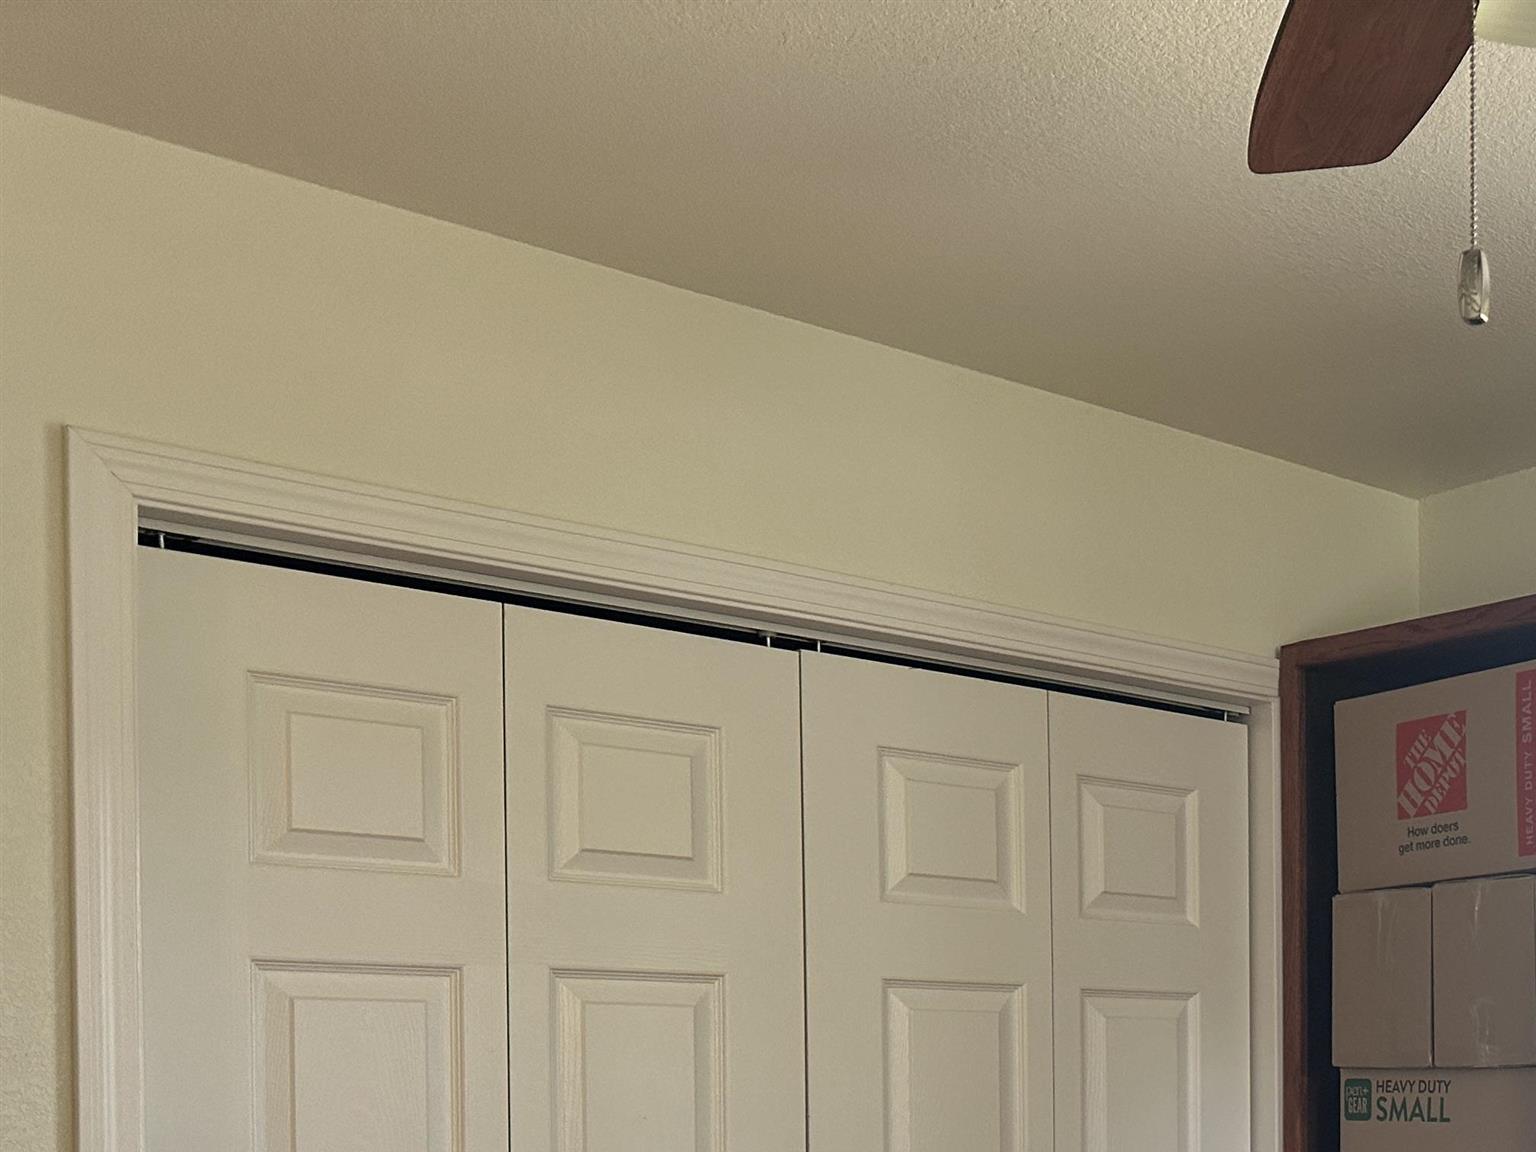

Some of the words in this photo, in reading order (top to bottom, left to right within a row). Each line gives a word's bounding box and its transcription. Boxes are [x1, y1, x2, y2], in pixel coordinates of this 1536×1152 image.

[1522, 680, 1532, 744] SMALL
[1397, 714, 1466, 818] HOME
[1405, 729, 1432, 769] THE
[1424, 748, 1466, 814] DEPOT
[1523, 751, 1533, 790] DUTY
[1407, 825, 1429, 838] How
[1431, 820, 1460, 834] doers
[1525, 798, 1535, 846] HEAVY
[1398, 841, 1414, 857] get
[1416, 838, 1440, 851] more
[1348, 1096, 1368, 1114] GEAR
[1376, 1079, 1416, 1094] HEAVY
[1418, 1079, 1452, 1094] DUTY
[1376, 1096, 1451, 1123] SMALL
